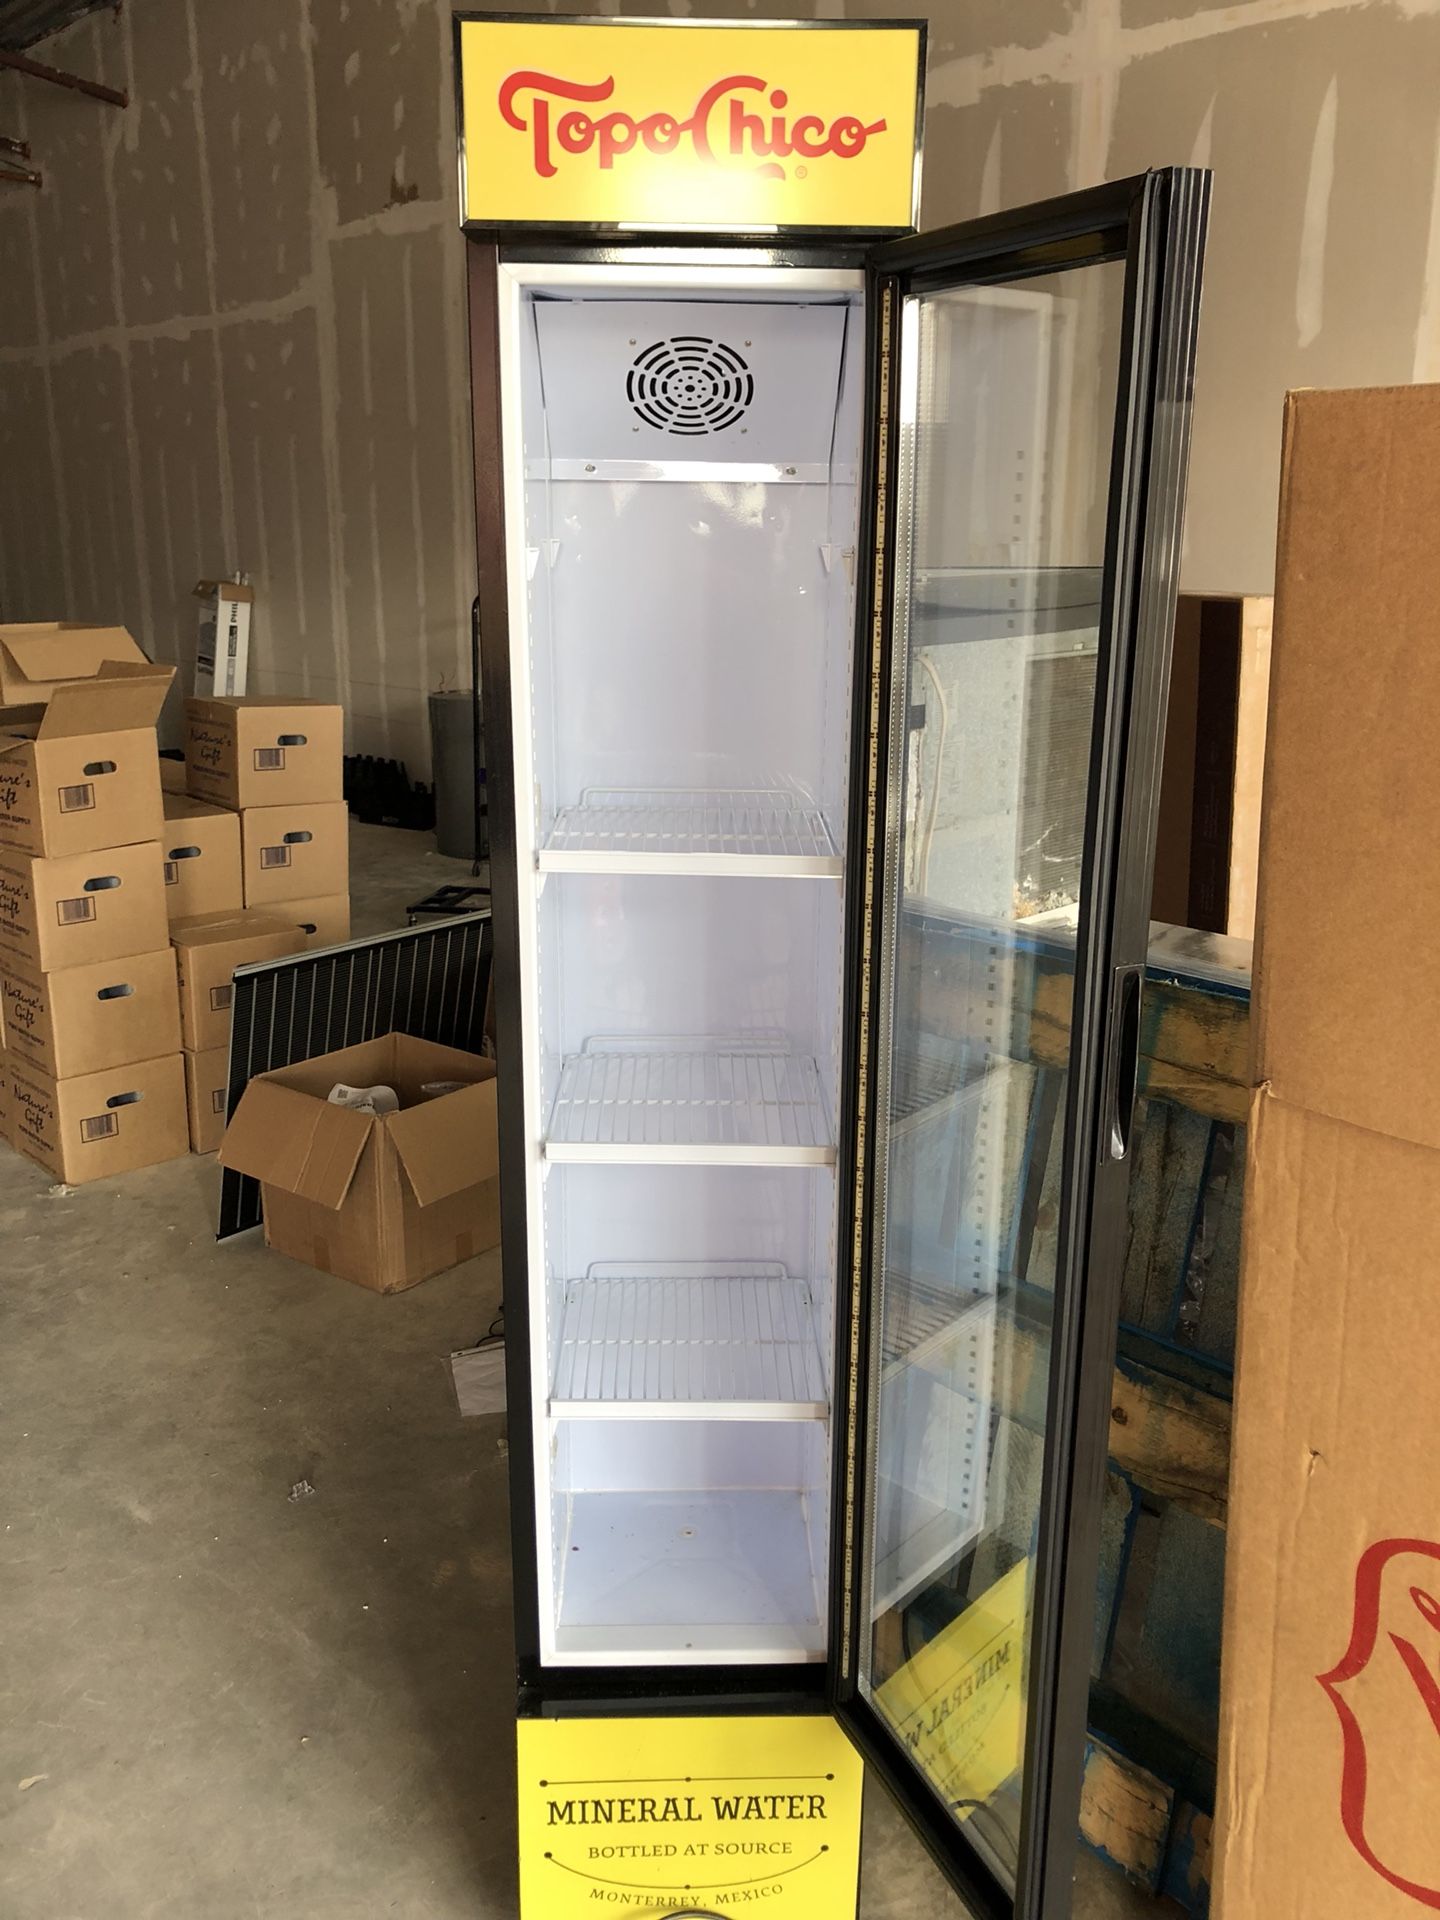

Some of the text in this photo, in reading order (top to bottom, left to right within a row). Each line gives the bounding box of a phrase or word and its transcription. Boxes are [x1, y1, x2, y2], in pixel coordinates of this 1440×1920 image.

[499, 71, 888, 181] Topo Chico
[547, 1795, 828, 1825] MINERAL WATER
[588, 1842, 793, 1859] BOTTLED AT SOURCE
[589, 1884, 784, 1908] MONTERREY, MEXICO
